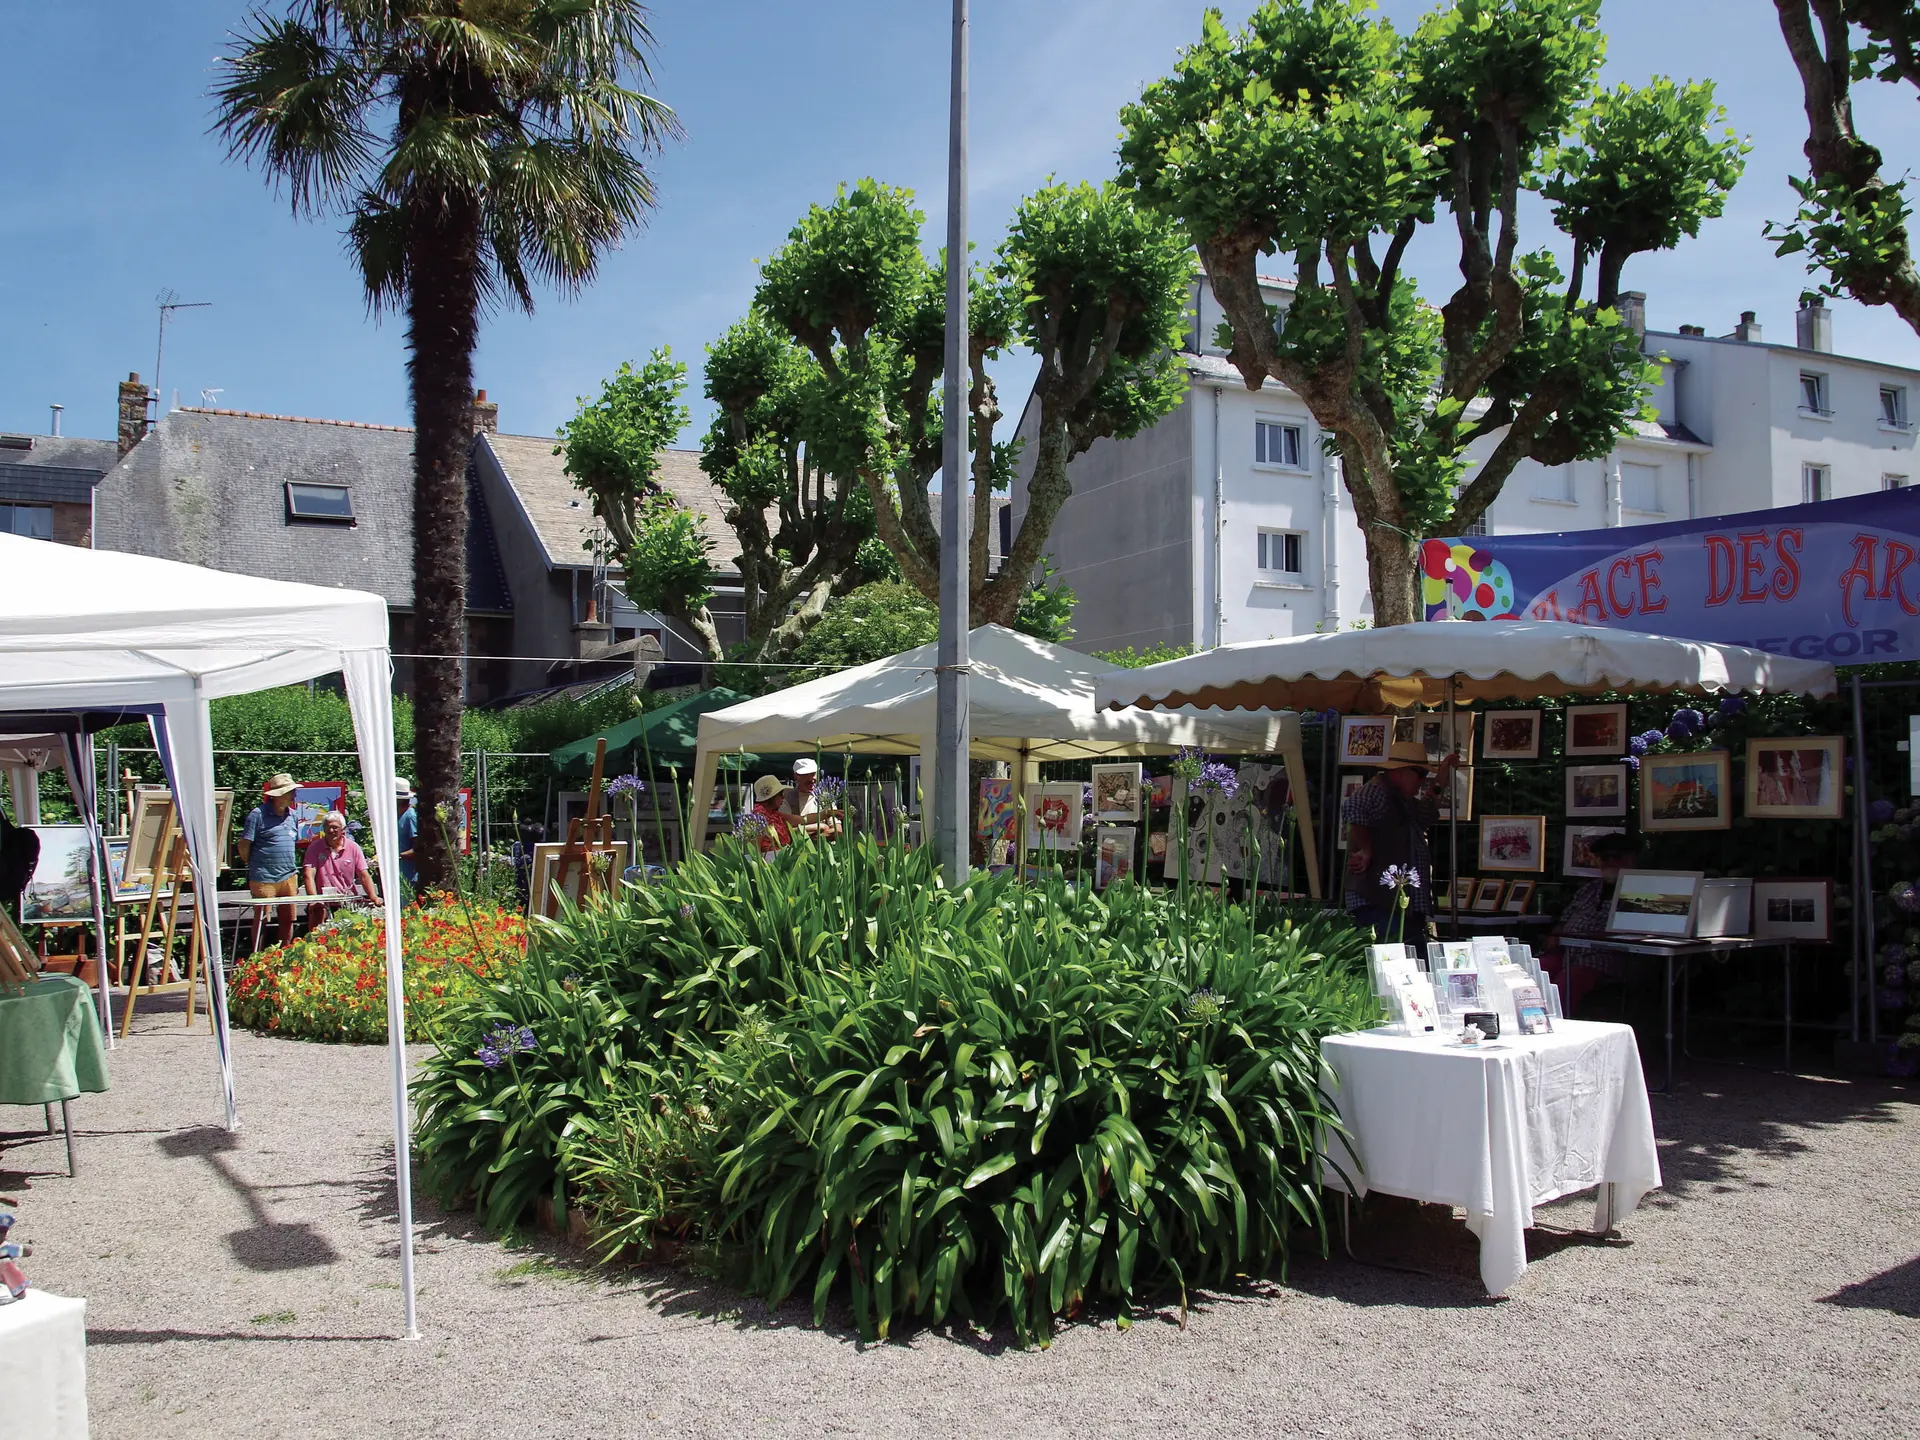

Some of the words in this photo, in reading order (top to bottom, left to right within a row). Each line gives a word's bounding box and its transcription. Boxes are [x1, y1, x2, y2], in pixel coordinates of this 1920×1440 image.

[1703, 527, 1804, 608] DES
[1839, 532, 1920, 628] AR
[1722, 628, 1901, 660] EGOR
